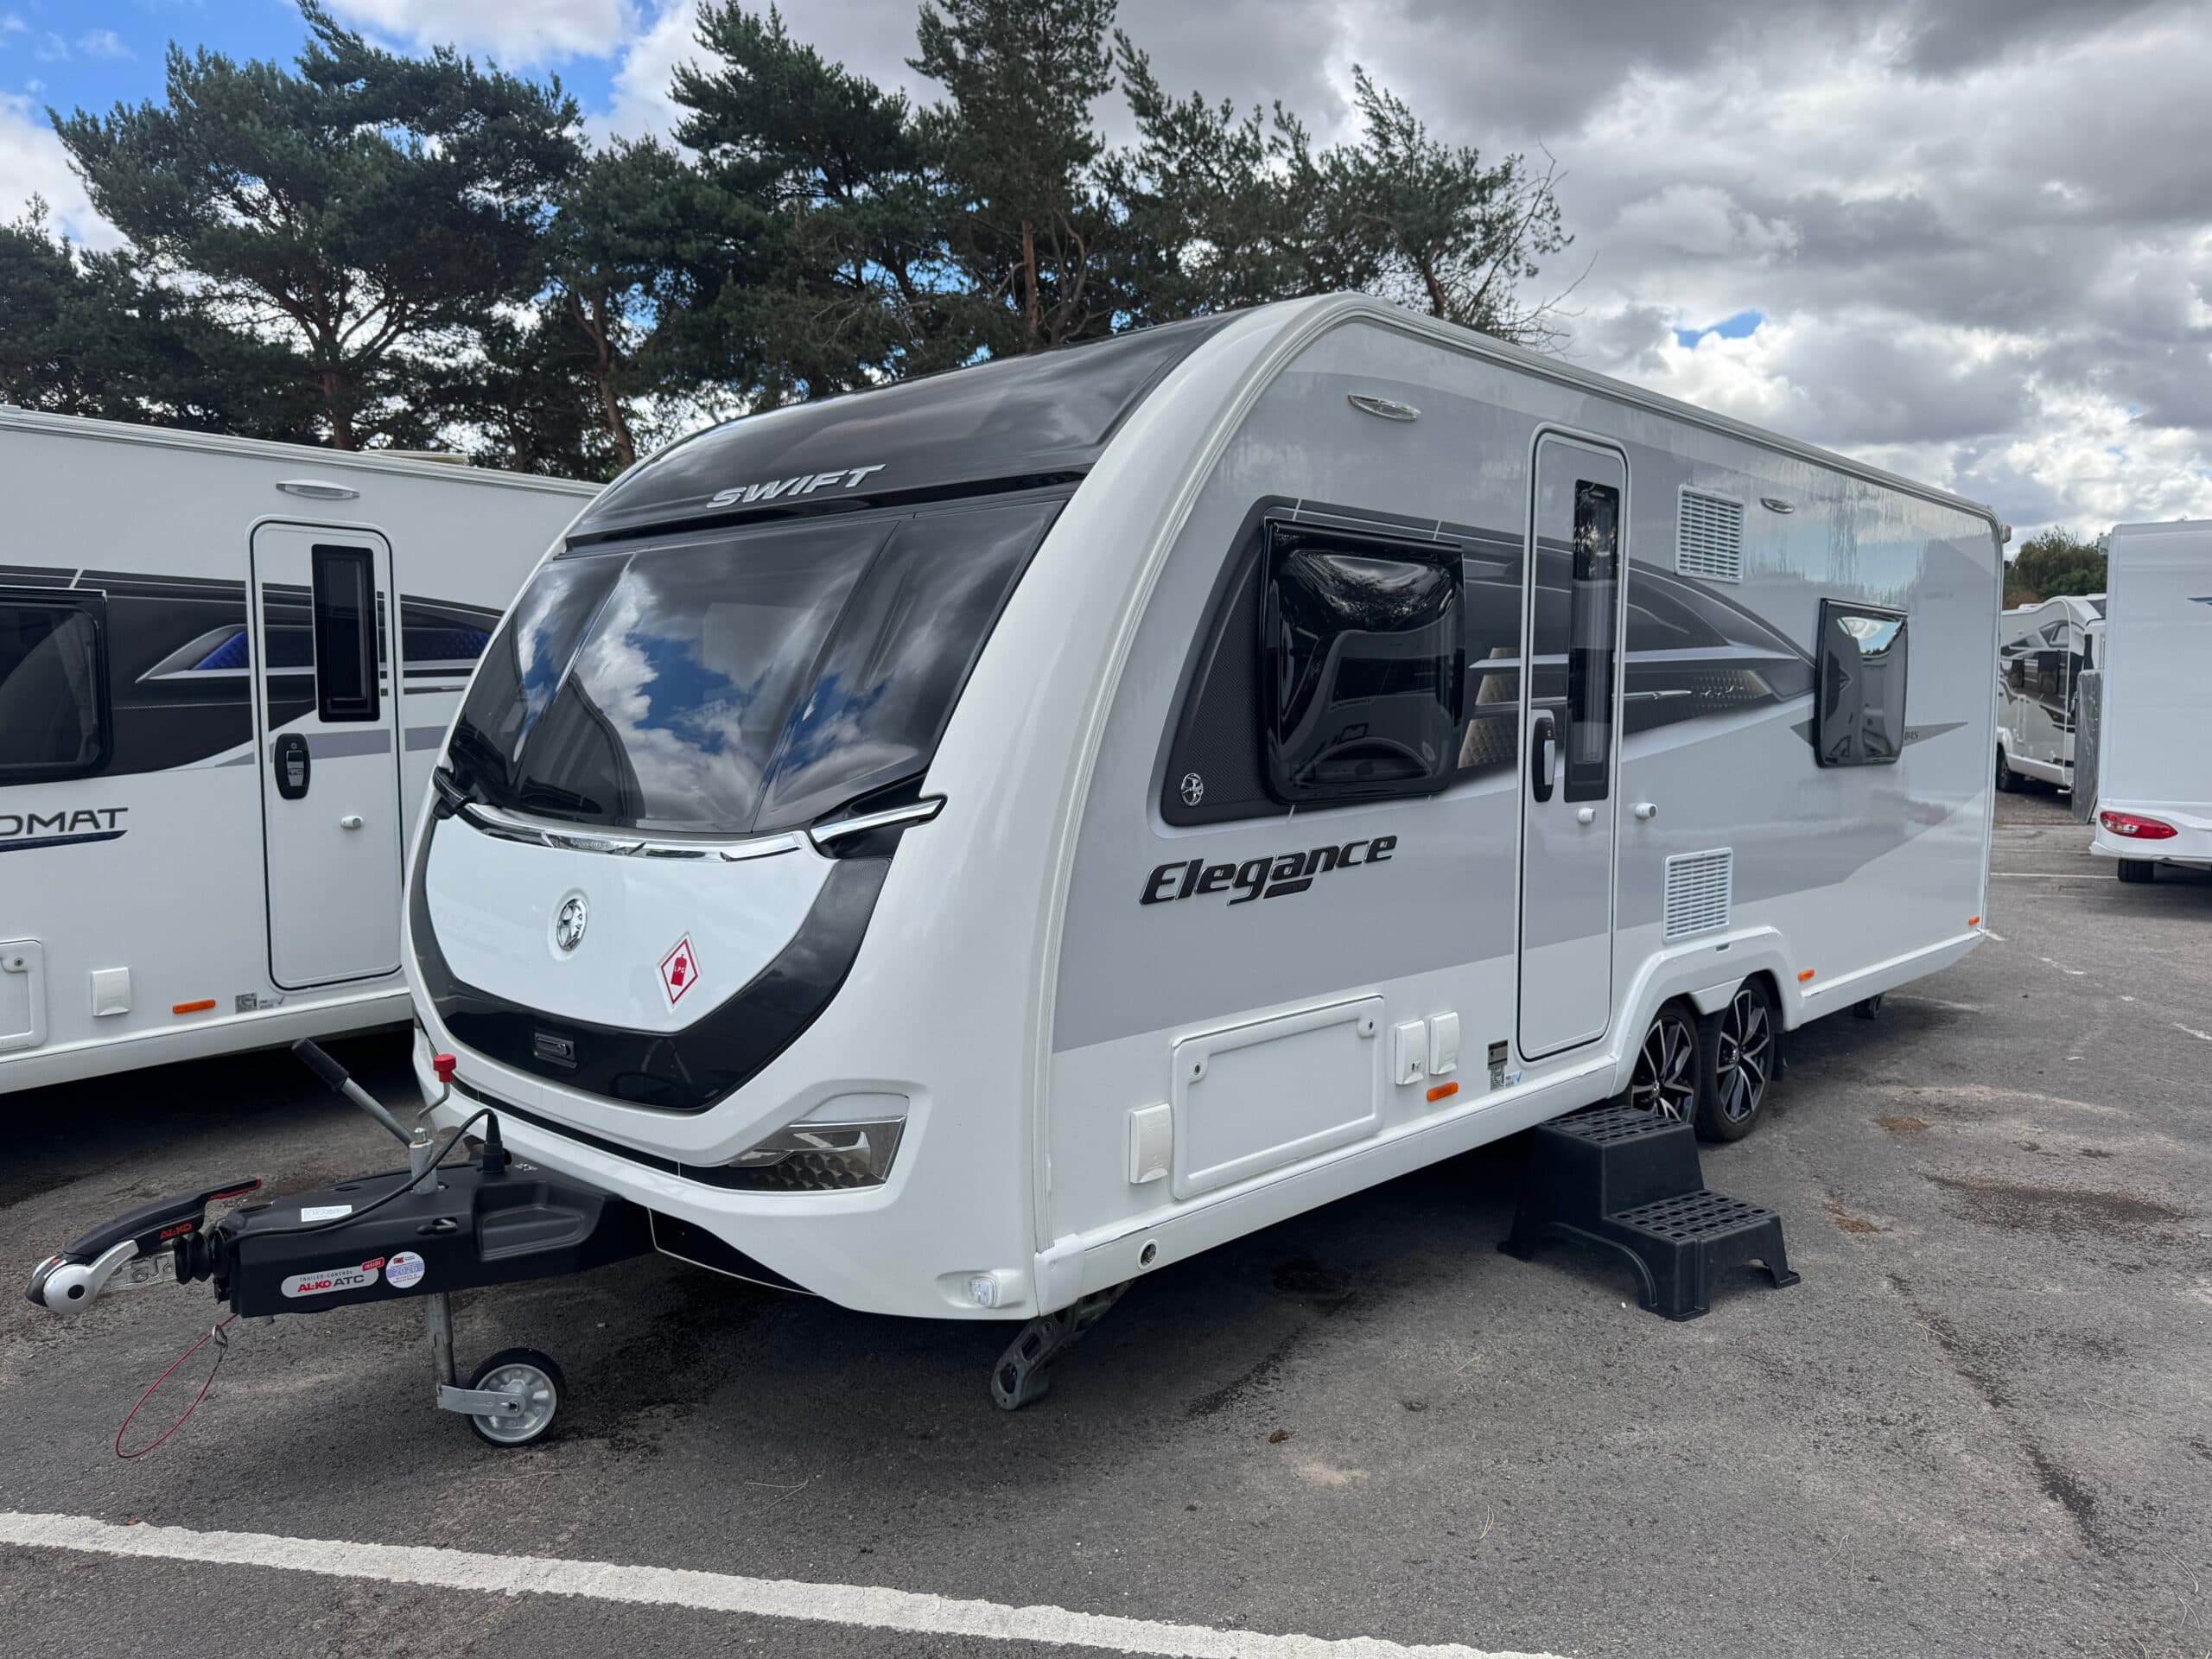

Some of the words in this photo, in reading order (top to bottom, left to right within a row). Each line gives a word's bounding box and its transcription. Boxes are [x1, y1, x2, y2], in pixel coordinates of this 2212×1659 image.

[706, 463, 887, 509] SWIFT
[1139, 835, 1398, 906] Elegance
[674, 965, 685, 974] LPG
[364, 1260, 381, 1269] INSIDE
[327, 1269, 353, 1278] CONTROL
[394, 1265, 418, 1276] 2026
[297, 1280, 332, 1293] AL-KO
[334, 1274, 365, 1287] ATC
